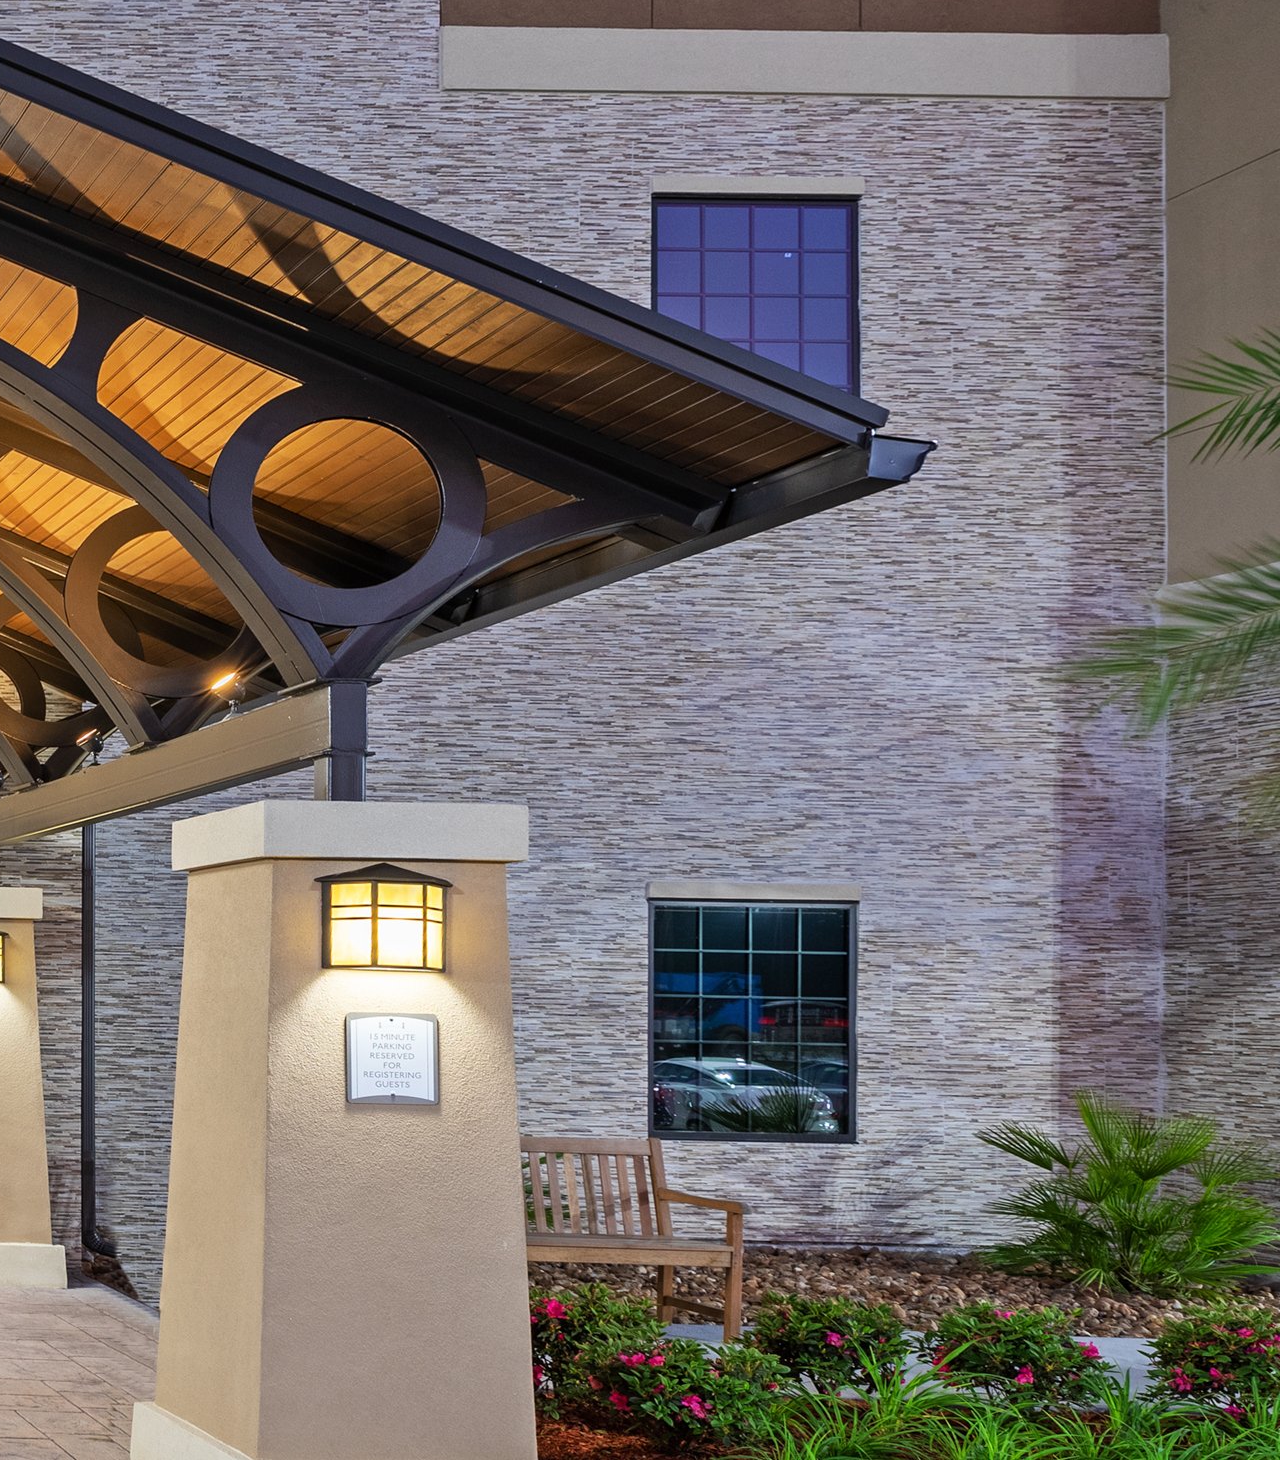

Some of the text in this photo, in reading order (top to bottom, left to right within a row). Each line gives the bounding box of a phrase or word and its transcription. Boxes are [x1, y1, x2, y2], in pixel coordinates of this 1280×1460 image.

[381, 1033, 416, 1041] MINUTE
[369, 1052, 415, 1060] RESERVED
[383, 1061, 401, 1069] FOR
[363, 1071, 422, 1079] REGISTERING
